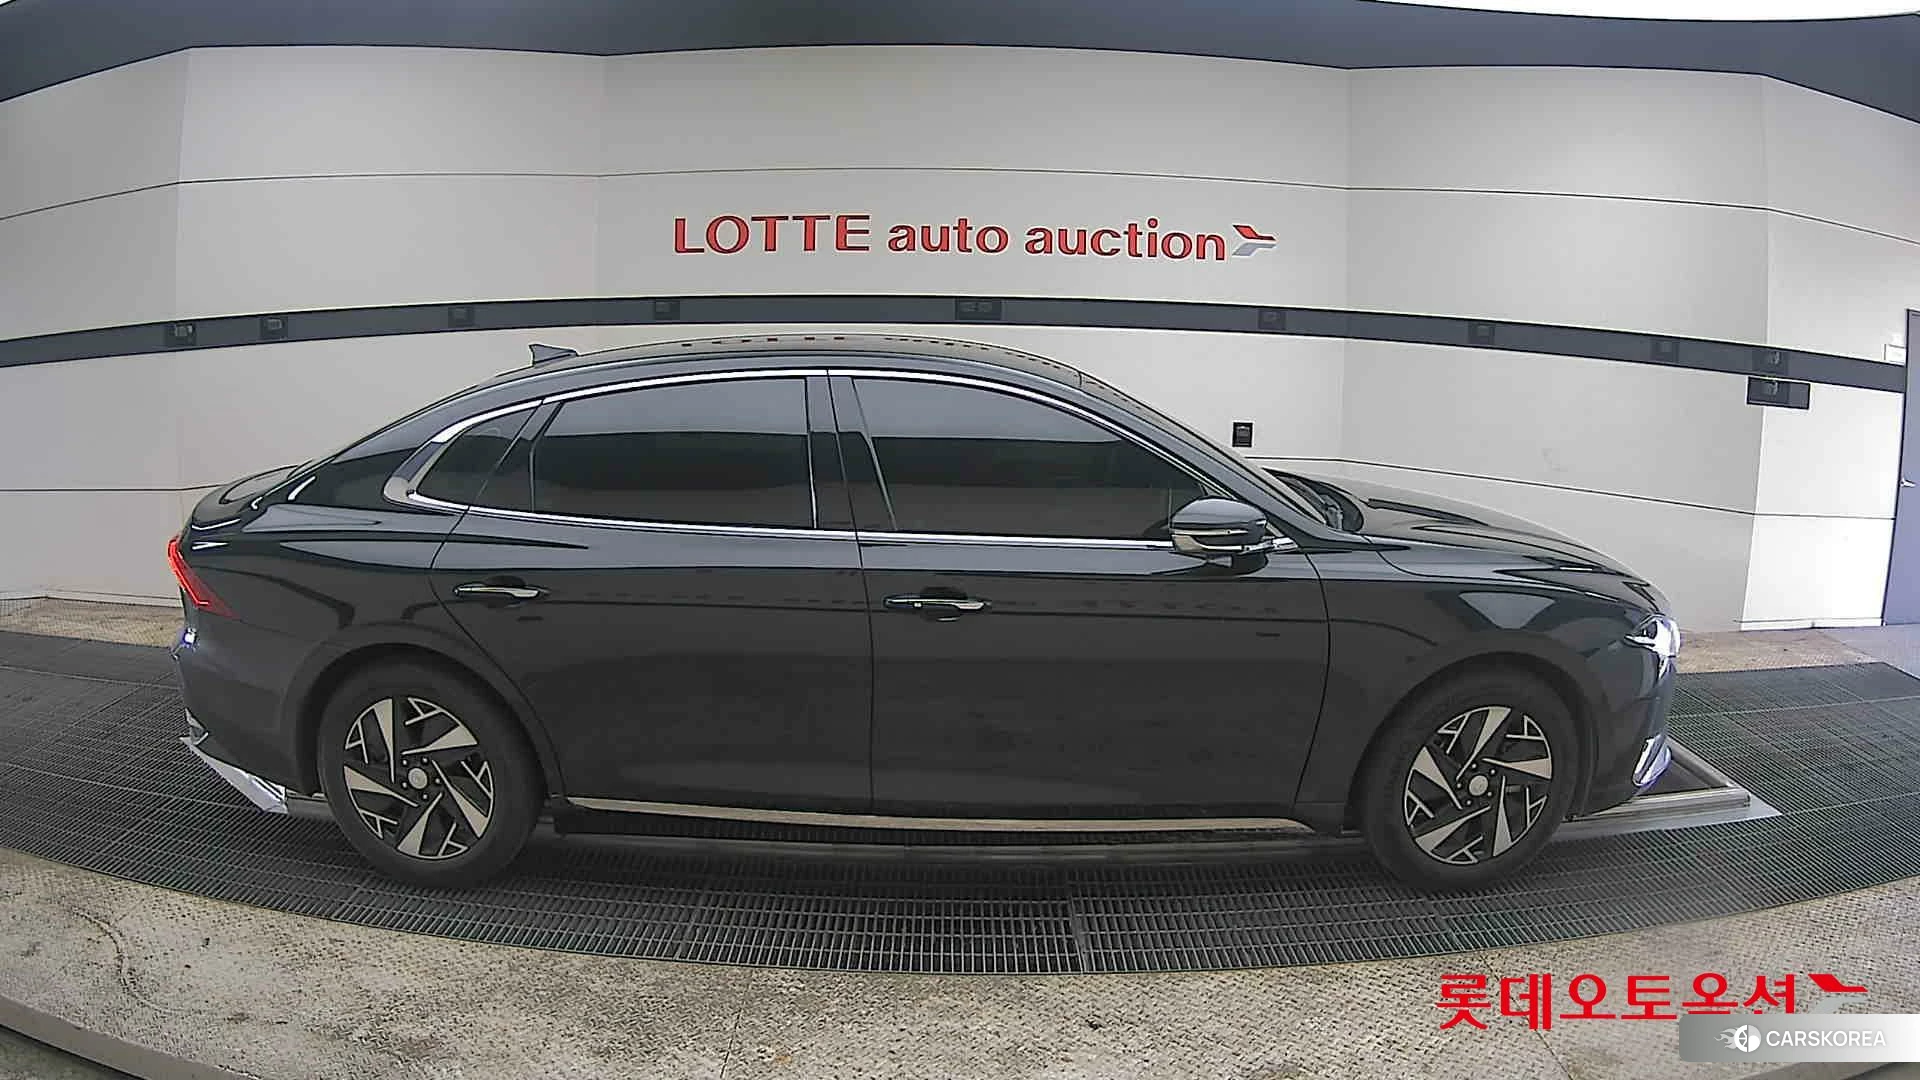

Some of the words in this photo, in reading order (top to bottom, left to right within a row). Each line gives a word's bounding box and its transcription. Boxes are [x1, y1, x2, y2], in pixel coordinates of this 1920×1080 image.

[673, 214, 871, 254] LOTTE
[887, 218, 1009, 254] auto
[1024, 218, 1226, 261] auction
